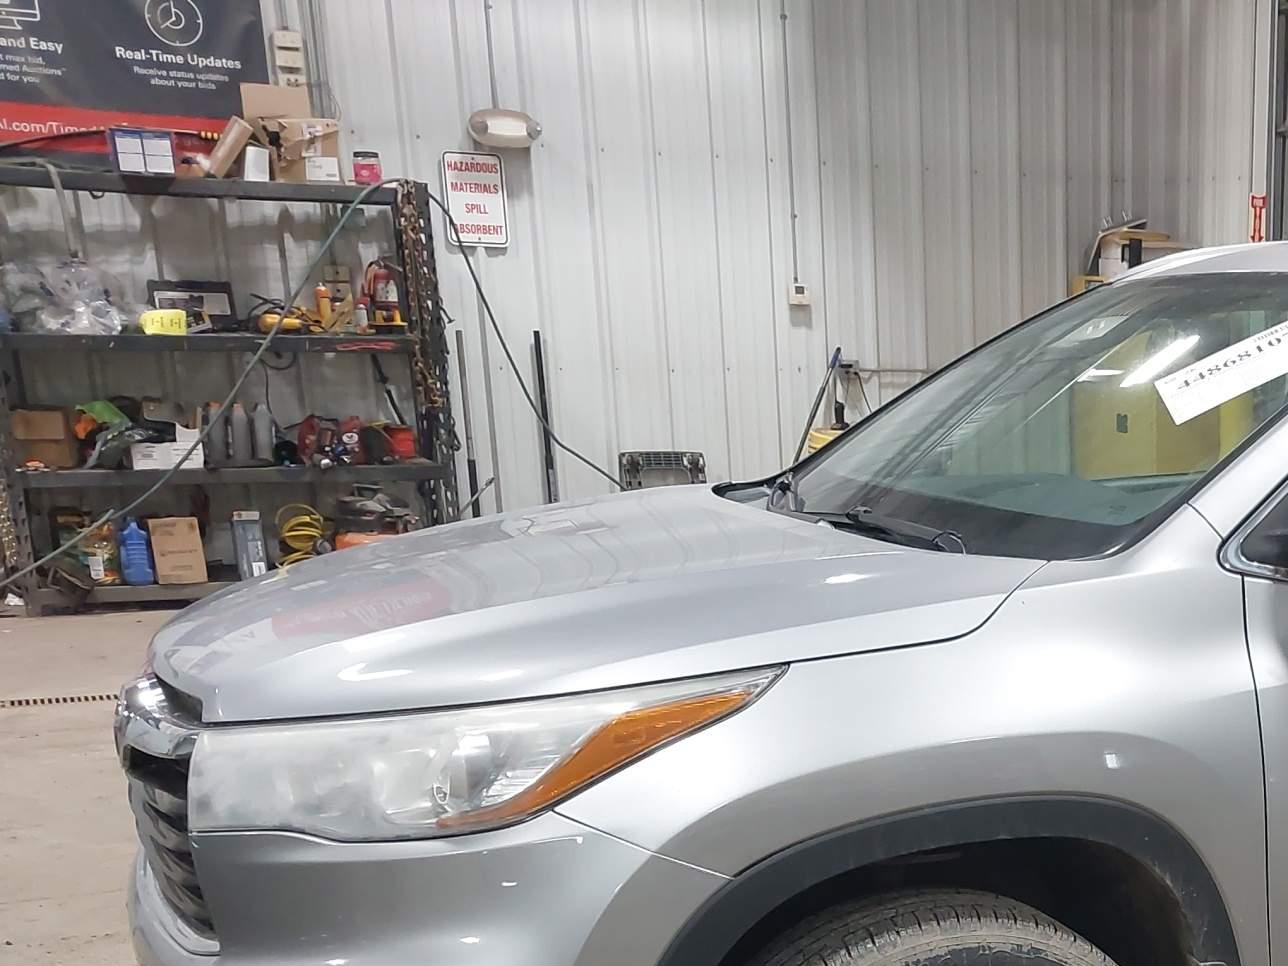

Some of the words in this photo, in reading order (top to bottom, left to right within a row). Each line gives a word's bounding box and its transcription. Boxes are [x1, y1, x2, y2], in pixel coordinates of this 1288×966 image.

[0, 37, 26, 48] and
[29, 37, 63, 54] Easy
[115, 47, 184, 64] Real-Time
[187, 53, 242, 69] Updates
[6, 72, 20, 81] for
[133, 66, 167, 77] Receive
[169, 70, 195, 79] status
[196, 73, 229, 82] updates
[150, 77, 175, 87] about
[176, 80, 196, 88] your
[447, 160, 499, 174] HAZARDOUS
[450, 181, 500, 195] MATERIALS
[464, 203, 489, 215] SPILL
